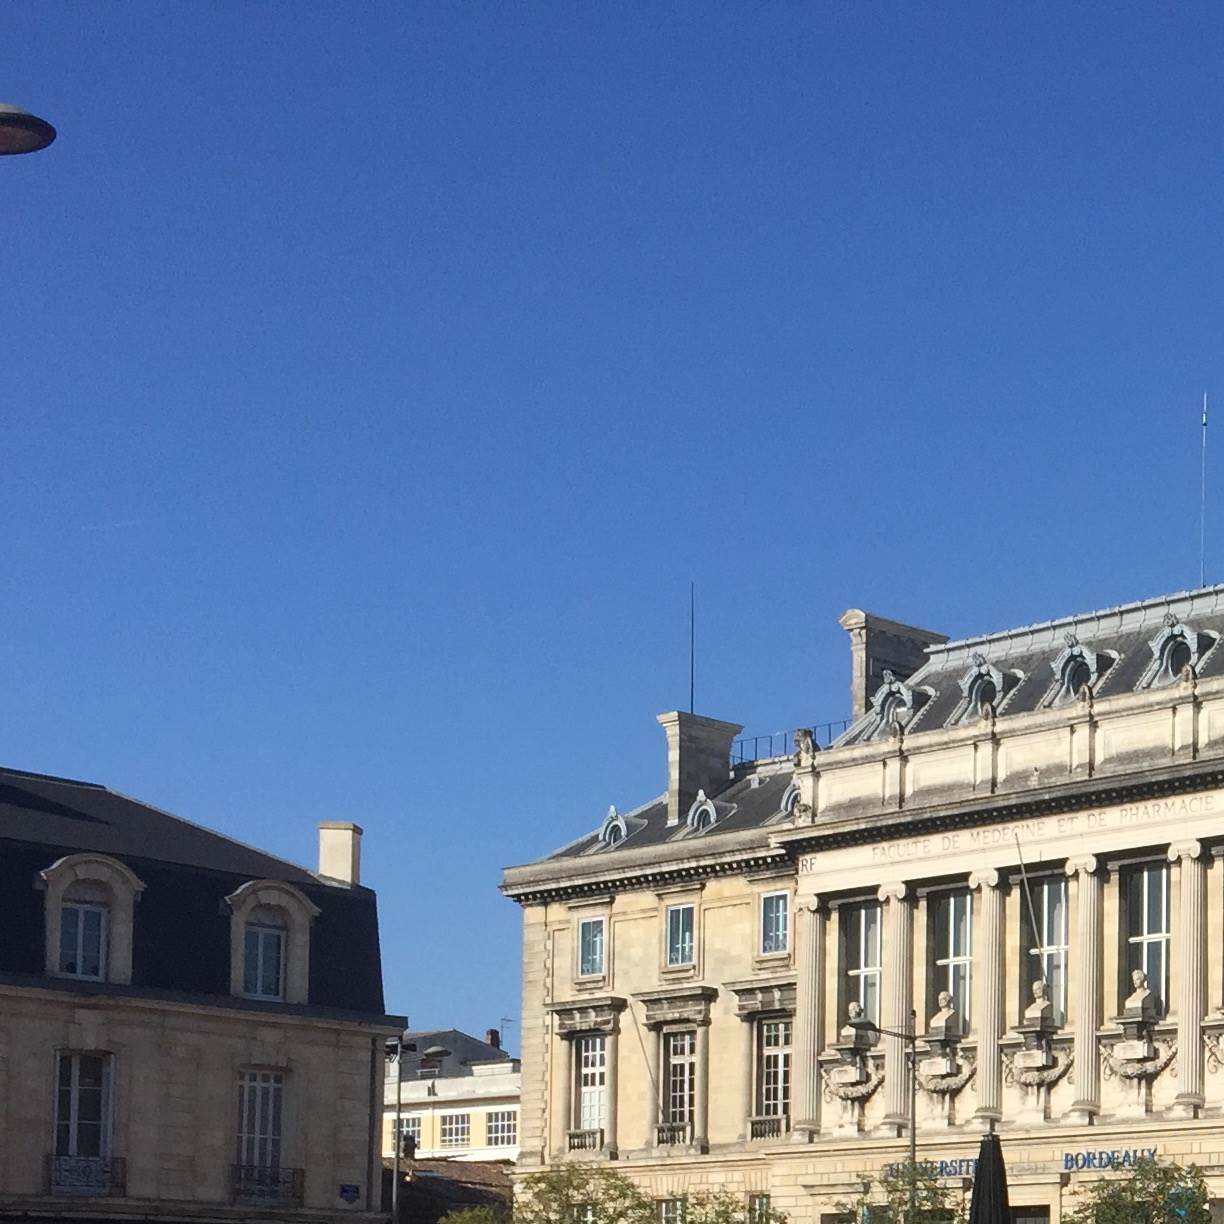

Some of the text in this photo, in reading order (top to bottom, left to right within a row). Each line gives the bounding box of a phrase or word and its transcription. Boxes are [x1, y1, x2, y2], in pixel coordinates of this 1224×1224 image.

[872, 840, 931, 861] FACULTE
[942, 836, 960, 851] DE
[1057, 817, 1078, 833] ET
[1088, 813, 1107, 829] DE
[1120, 795, 1216, 824] PHARMACIE
[800, 857, 817, 872] RF
